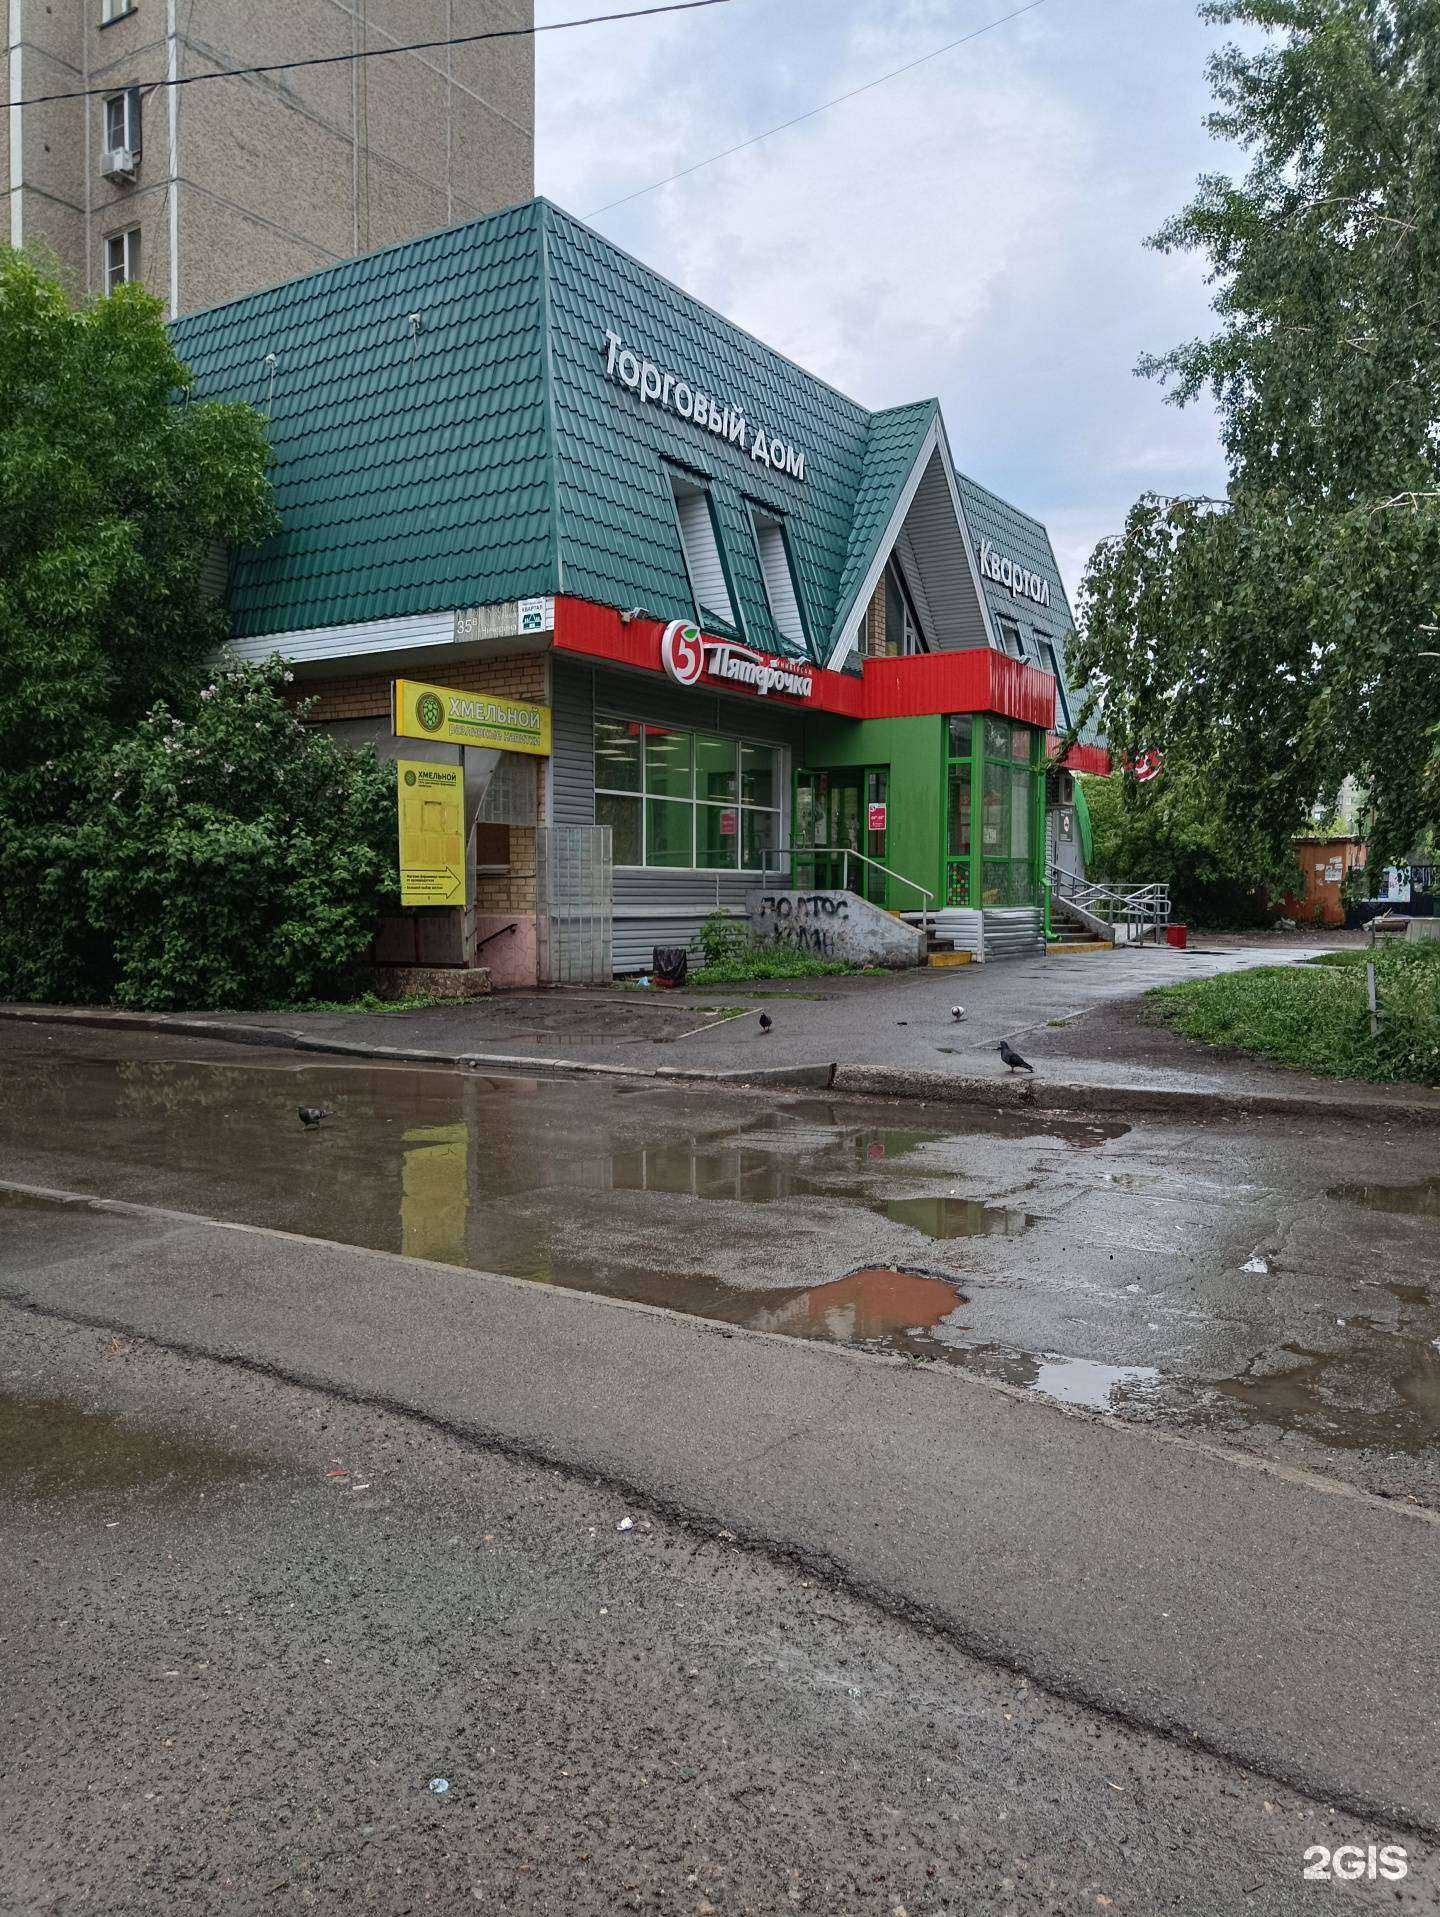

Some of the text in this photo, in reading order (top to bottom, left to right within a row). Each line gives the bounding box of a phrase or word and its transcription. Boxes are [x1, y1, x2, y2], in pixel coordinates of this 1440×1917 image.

[605, 329, 746, 450] Торговый
[981, 538, 1050, 607] Квартал
[449, 697, 541, 729] ХМЕЛЬНОЙ
[418, 771, 456, 781] ХМЕЛЬНОЙ
